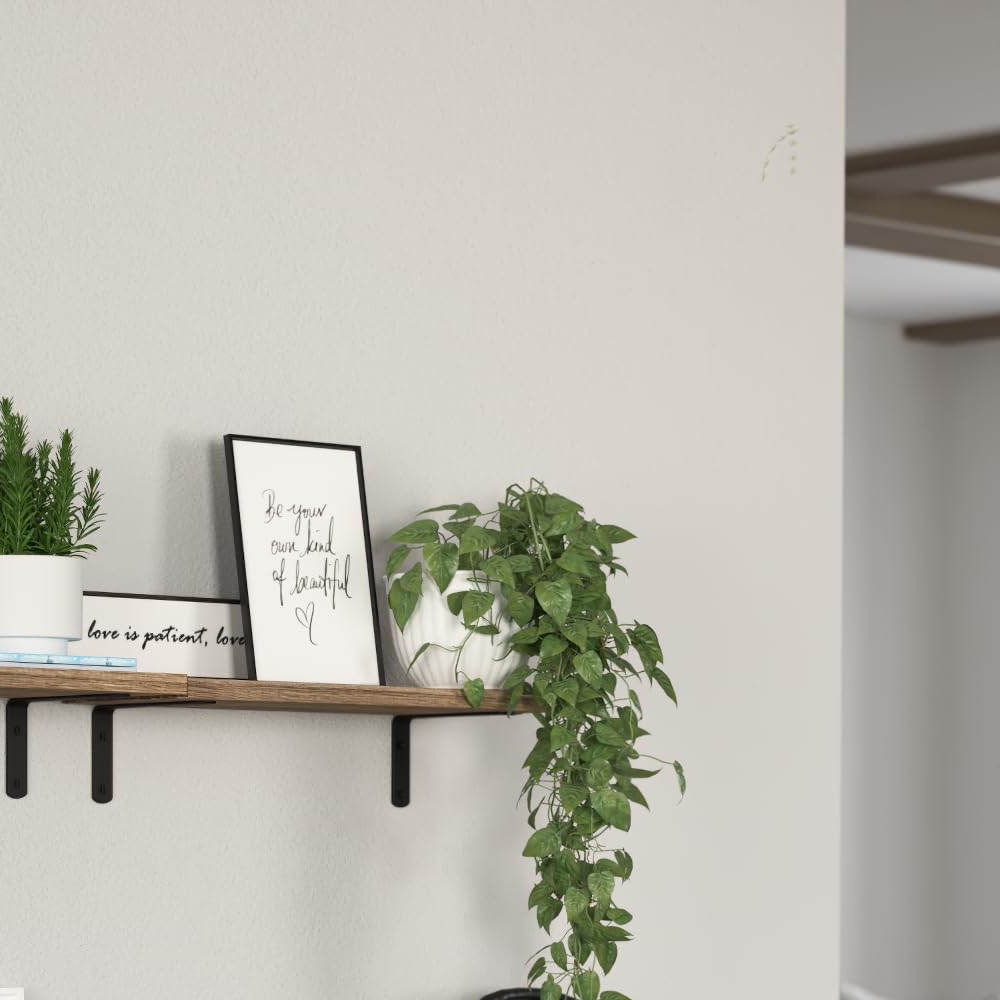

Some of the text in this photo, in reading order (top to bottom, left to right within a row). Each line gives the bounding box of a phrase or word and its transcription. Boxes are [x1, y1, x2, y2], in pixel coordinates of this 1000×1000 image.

[262, 488, 327, 536] Be your
[271, 516, 336, 558] own kind
[272, 554, 352, 610] of beautiful
[87, 619, 120, 641] love
[124, 626, 140, 641] is
[142, 625, 208, 650] patient,
